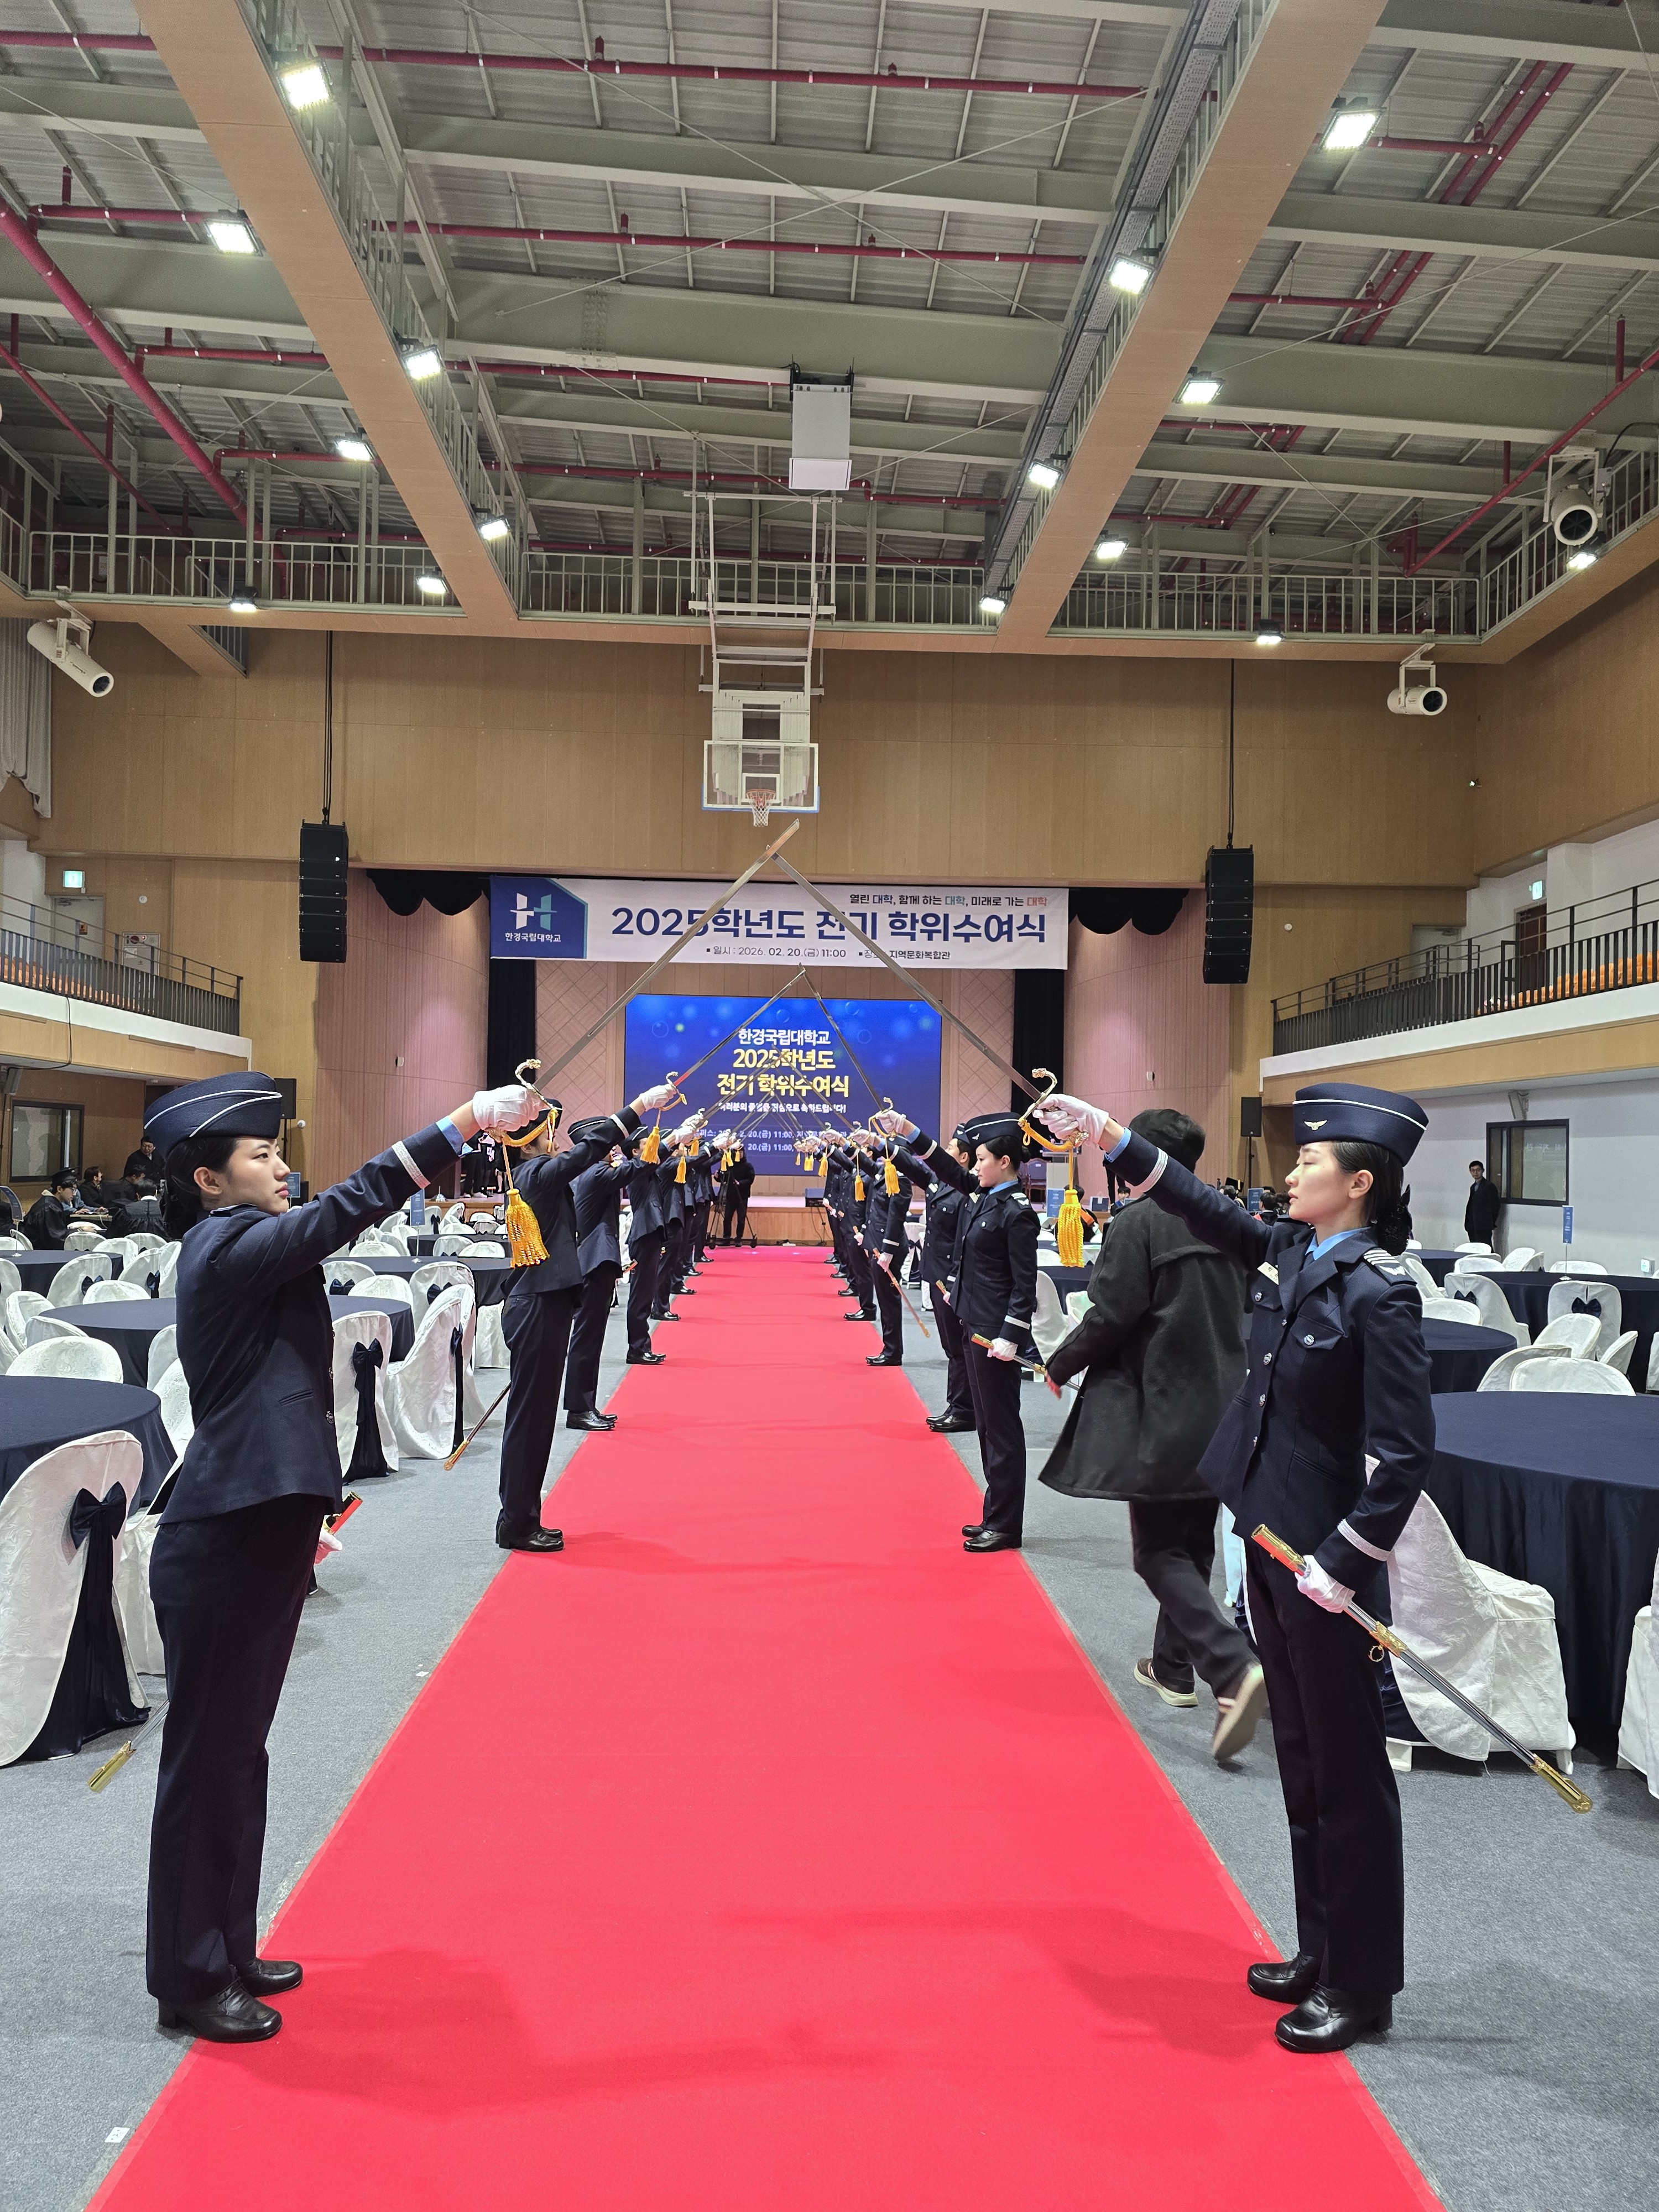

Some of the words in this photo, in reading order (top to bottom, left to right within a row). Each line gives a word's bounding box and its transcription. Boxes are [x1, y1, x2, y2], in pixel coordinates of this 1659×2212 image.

[849, 894, 870, 904] 열린
[873, 894, 896, 905] 대학,
[899, 895, 920, 905] 함께
[922, 895, 942, 906] 하는
[945, 895, 968, 906] 대학,
[971, 896, 1001, 906] 미래로
[1004, 896, 1024, 907] 가는
[1027, 896, 1047, 907] 대학
[612, 907, 806, 938] 2025학년도
[816, 911, 878, 940] 전기
[888, 911, 1046, 943] 학위수여식
[505, 932, 562, 943] 한경국립대학교
[713, 946, 731, 955] 일시
[738, 947, 766, 956] 2026.
[769, 948, 785, 957] 02.
[822, 949, 846, 957] 11:00
[889, 950, 951, 960] 지역문화복합관
[738, 1029, 831, 1046] 한경국립대학교
[733, 1048, 836, 1071] 2025학년도
[717, 1073, 754, 1096] 전기
[757, 1074, 849, 1098] 학위수여식
